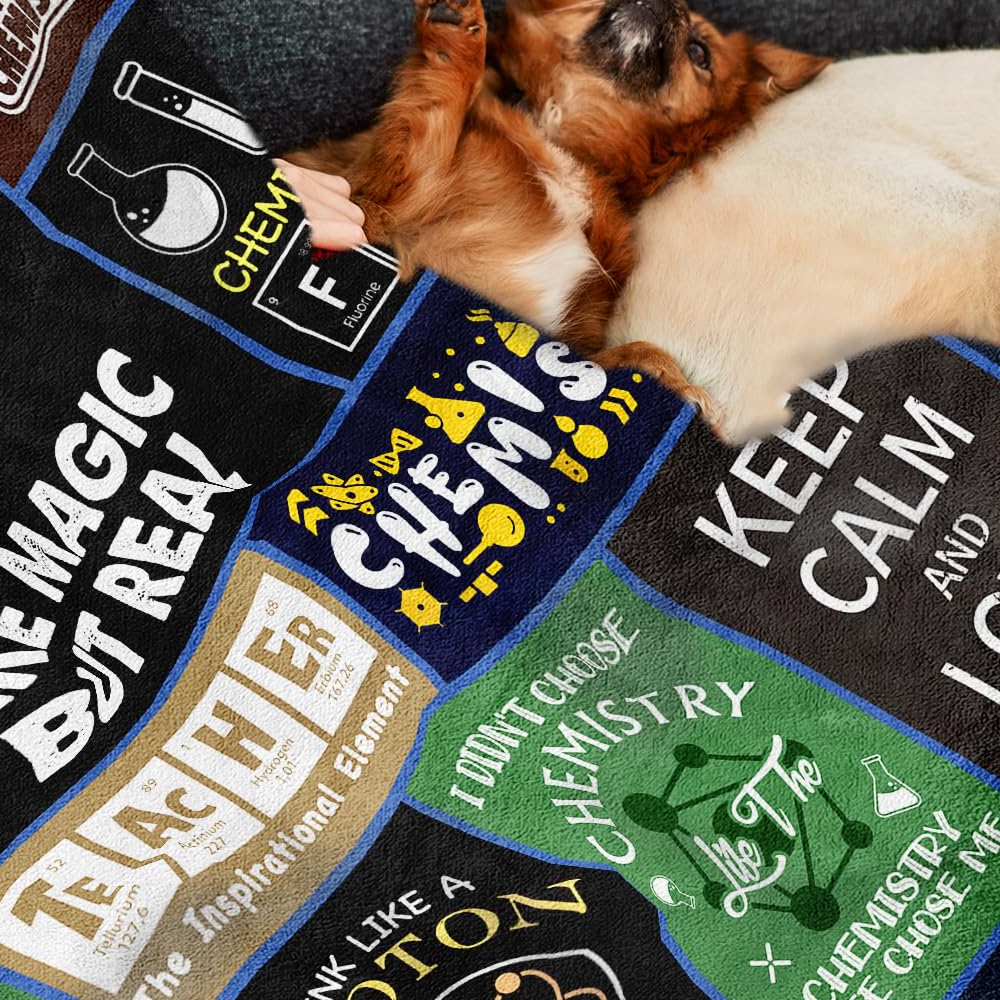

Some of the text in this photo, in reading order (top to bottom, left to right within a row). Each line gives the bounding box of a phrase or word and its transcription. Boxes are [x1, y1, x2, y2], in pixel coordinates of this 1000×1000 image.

[298, 264, 347, 310] F
[343, 281, 381, 329] Fluorine
[800, 395, 975, 614] CALM
[923, 512, 990, 601] AND
[0, 432, 252, 781] BUT REAL
[264, 600, 279, 618] 68
[314, 653, 342, 695] Erbium
[328, 662, 355, 701] 167.26
[450, 607, 640, 810] I DIDN'T CHOOSE
[141, 777, 157, 794] 89
[250, 738, 294, 788] Hydrogen
[540, 681, 755, 865] CHEMISTRY
[731, 734, 822, 837] The
[46, 857, 66, 874] 52
[133, 663, 411, 1000] The Inspirational Element
[203, 836, 226, 855] 227
[93, 884, 142, 957] Tellurium
[117, 906, 149, 950] 127.6
[346, 889, 431, 953] LIKE
[440, 874, 476, 899] A
[802, 810, 961, 1000] CHEMISTRY
[883, 871, 971, 974] CHOSE
